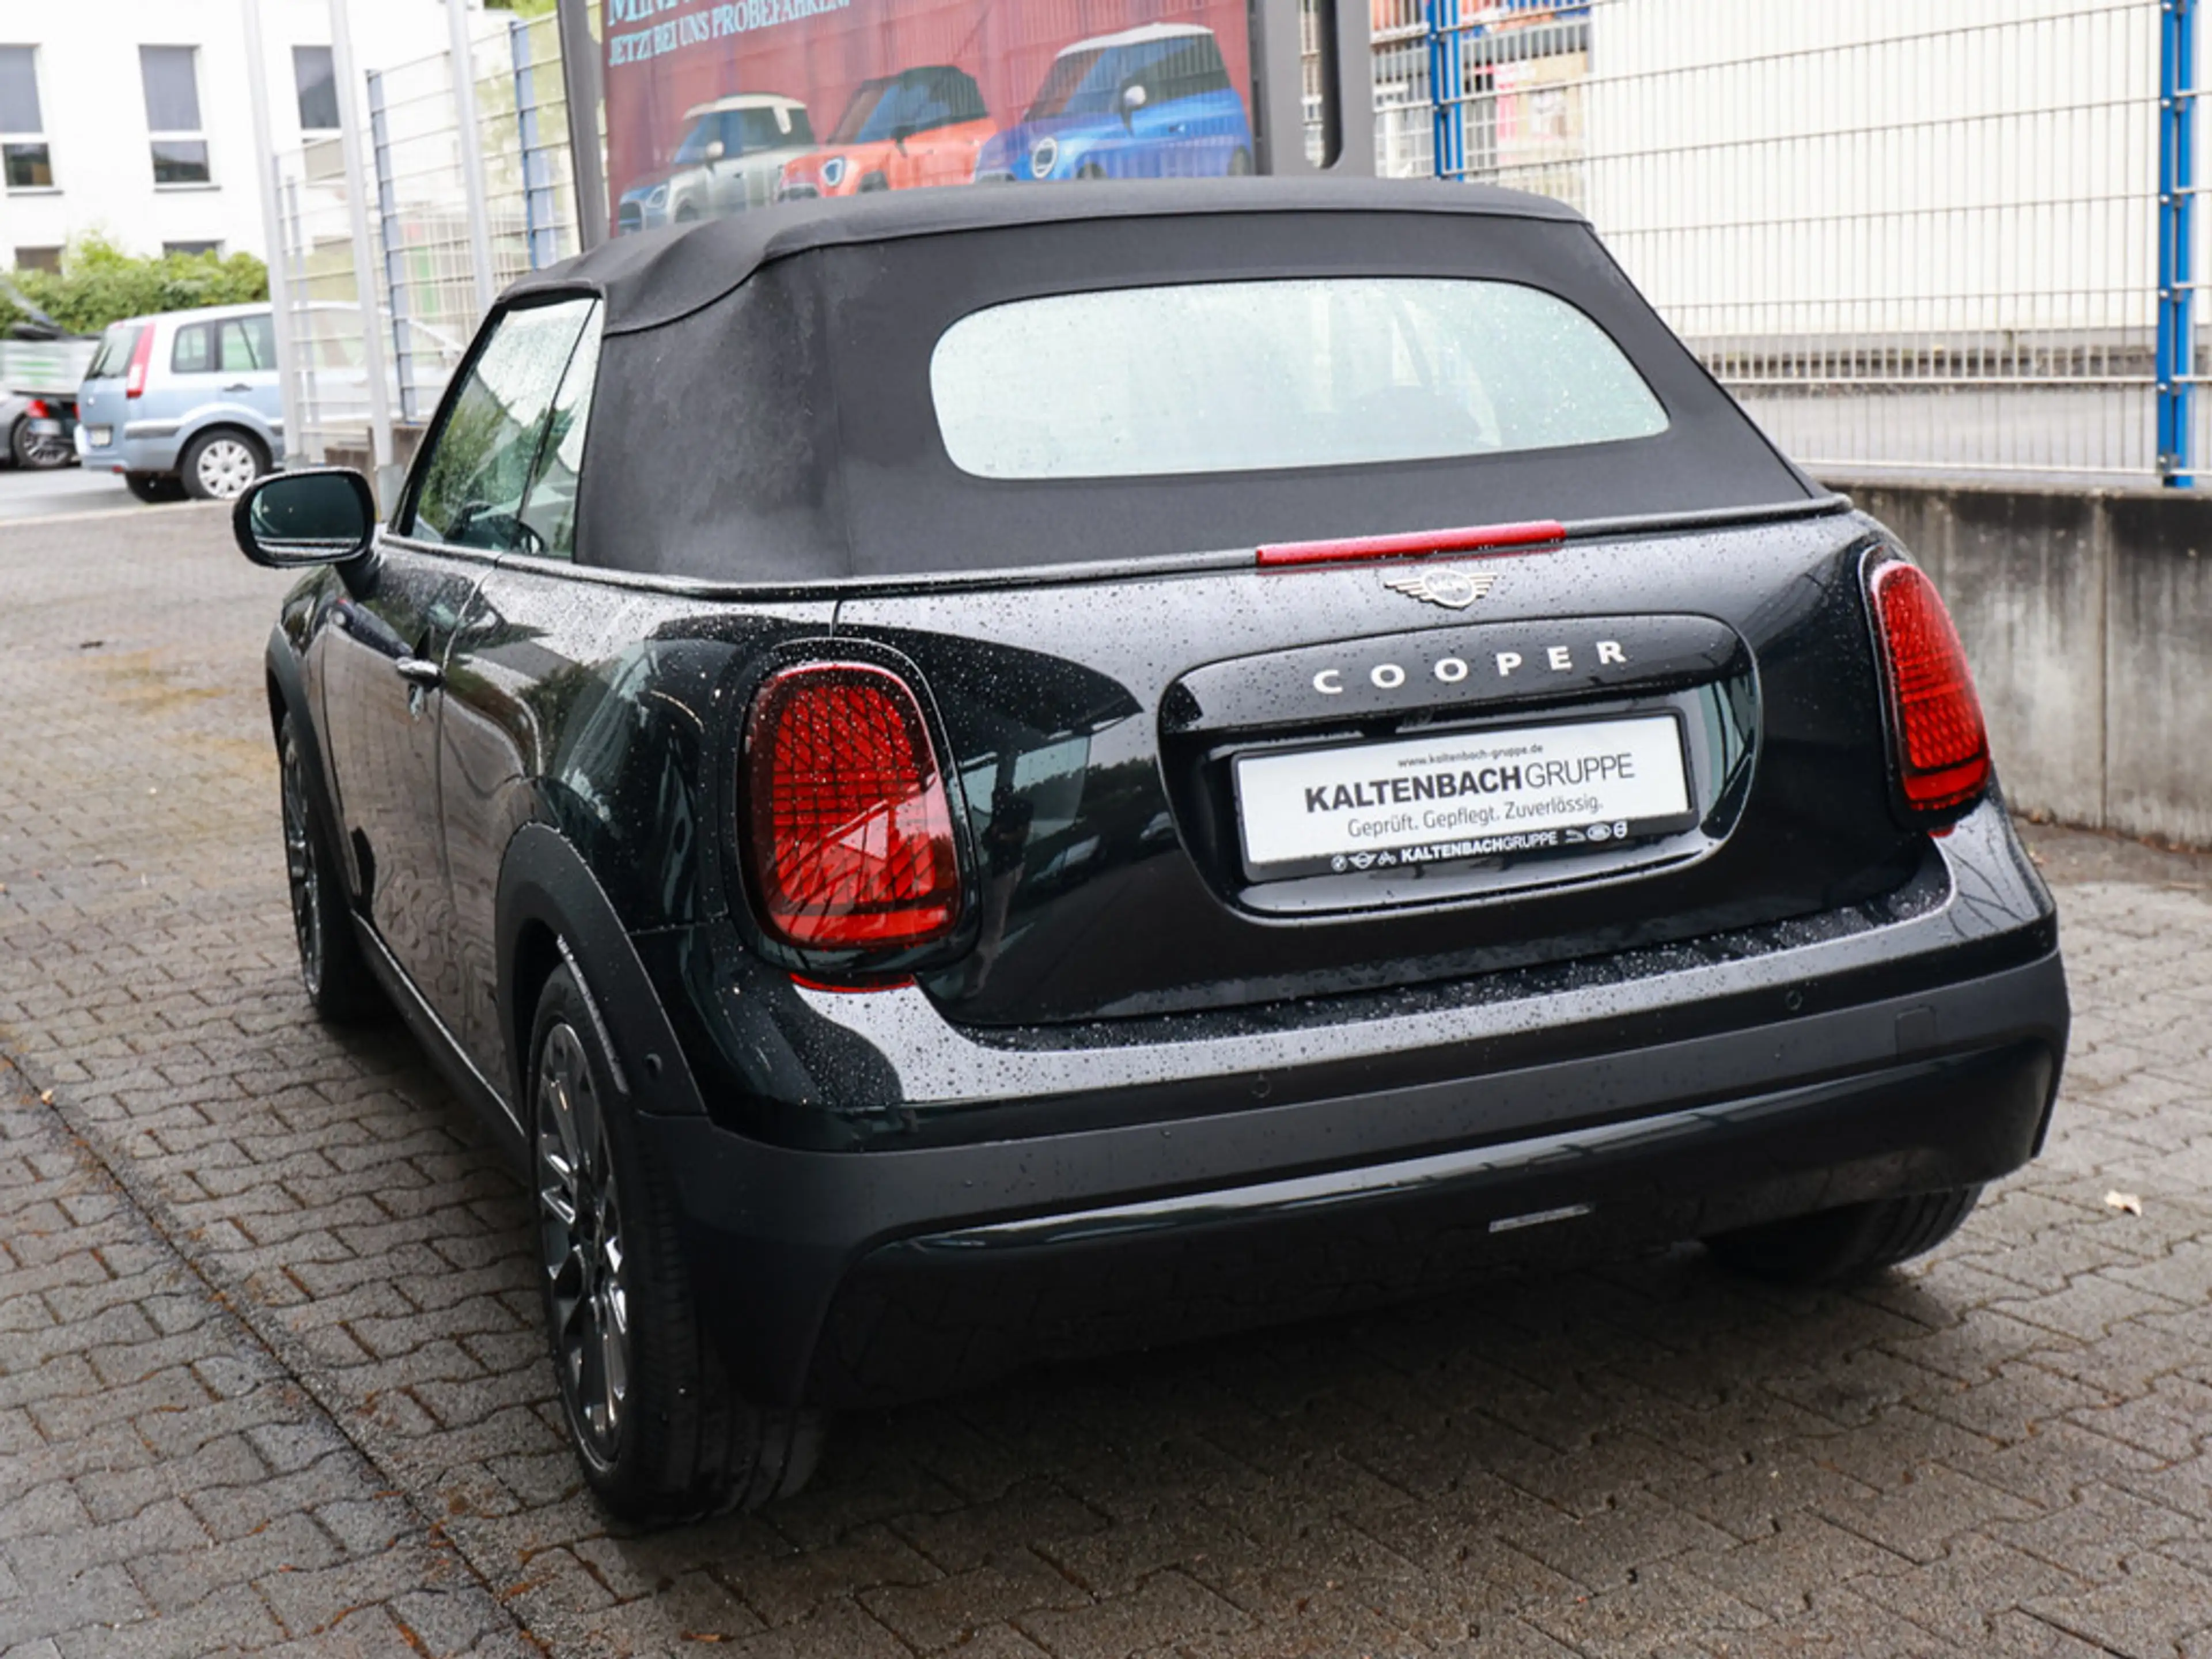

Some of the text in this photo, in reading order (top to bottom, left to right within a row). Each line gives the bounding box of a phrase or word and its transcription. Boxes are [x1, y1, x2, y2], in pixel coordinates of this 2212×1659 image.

[608, 29, 653, 67] JETZT
[653, 21, 677, 55] BEI
[679, 12, 710, 46] UNS
[1312, 641, 1627, 695] COOPER
[1397, 743, 1543, 767] www.kaltenbach-gruppe.de
[1305, 753, 1635, 813] KALTENBACHGRUPPE
[1347, 794, 1604, 838] Geprüft. Gepflegt. Zuverlässig.
[1401, 831, 1558, 863] KALTENBACHGRUPPE
